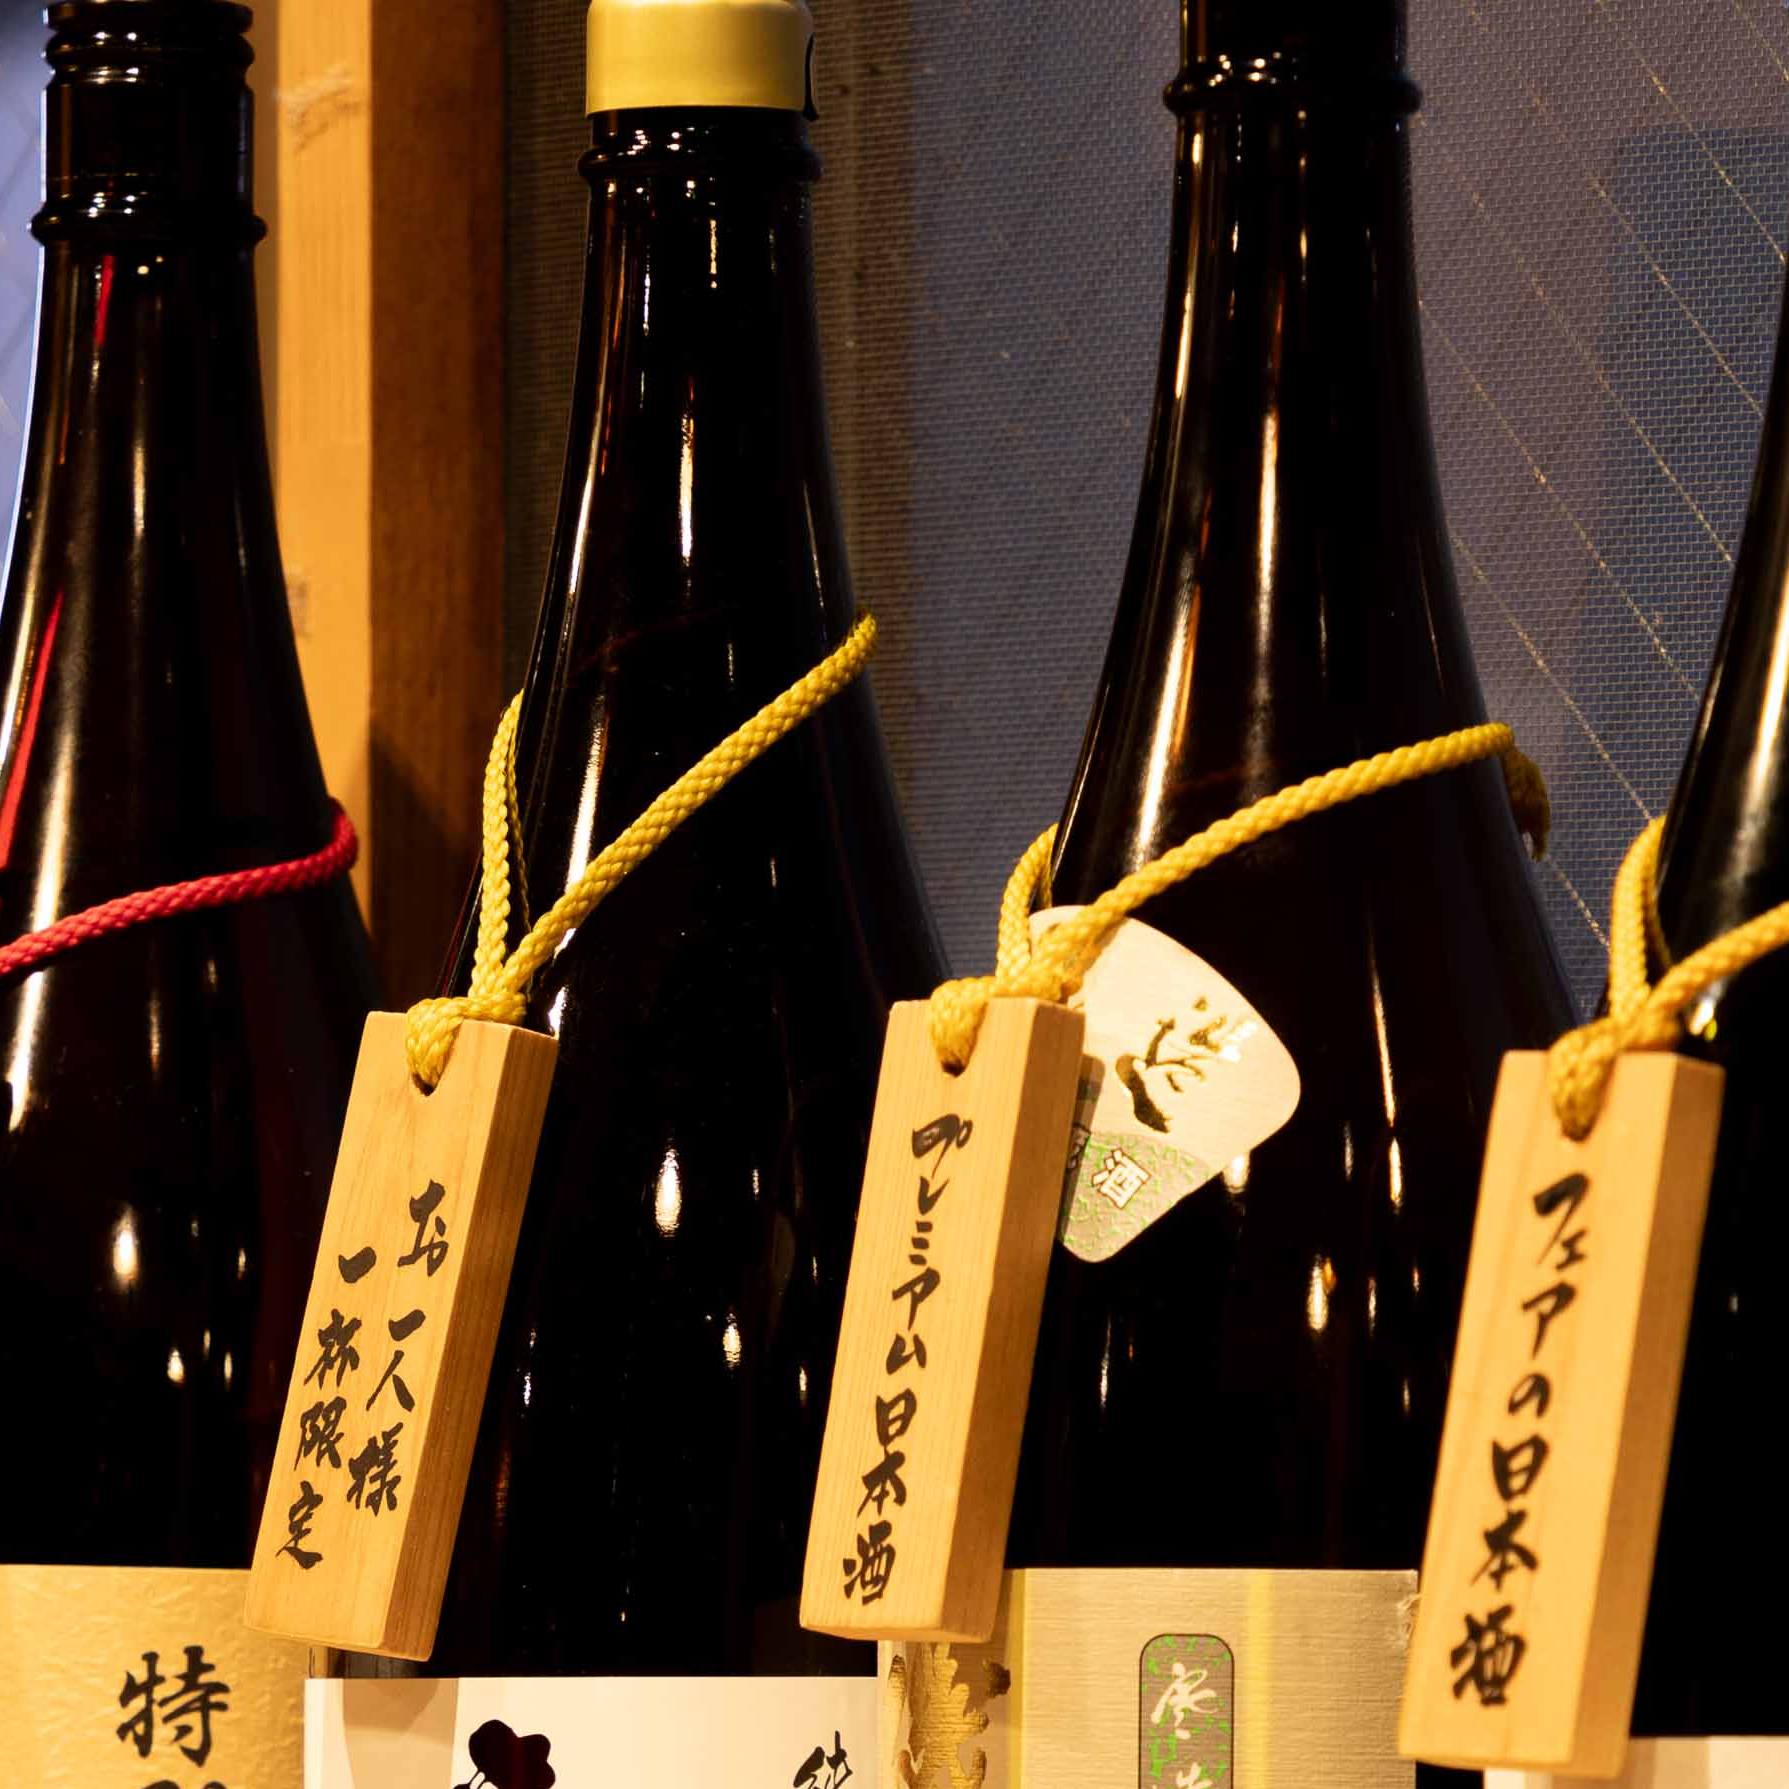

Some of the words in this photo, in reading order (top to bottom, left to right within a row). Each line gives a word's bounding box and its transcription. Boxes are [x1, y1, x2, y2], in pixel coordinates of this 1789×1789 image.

[276, 1247, 377, 1570] 一杯限定
[347, 1180, 448, 1516] お一人様
[841, 1114, 973, 1606] プレミアム日本酒
[1450, 1172, 1592, 1707] フェアの日本酒
